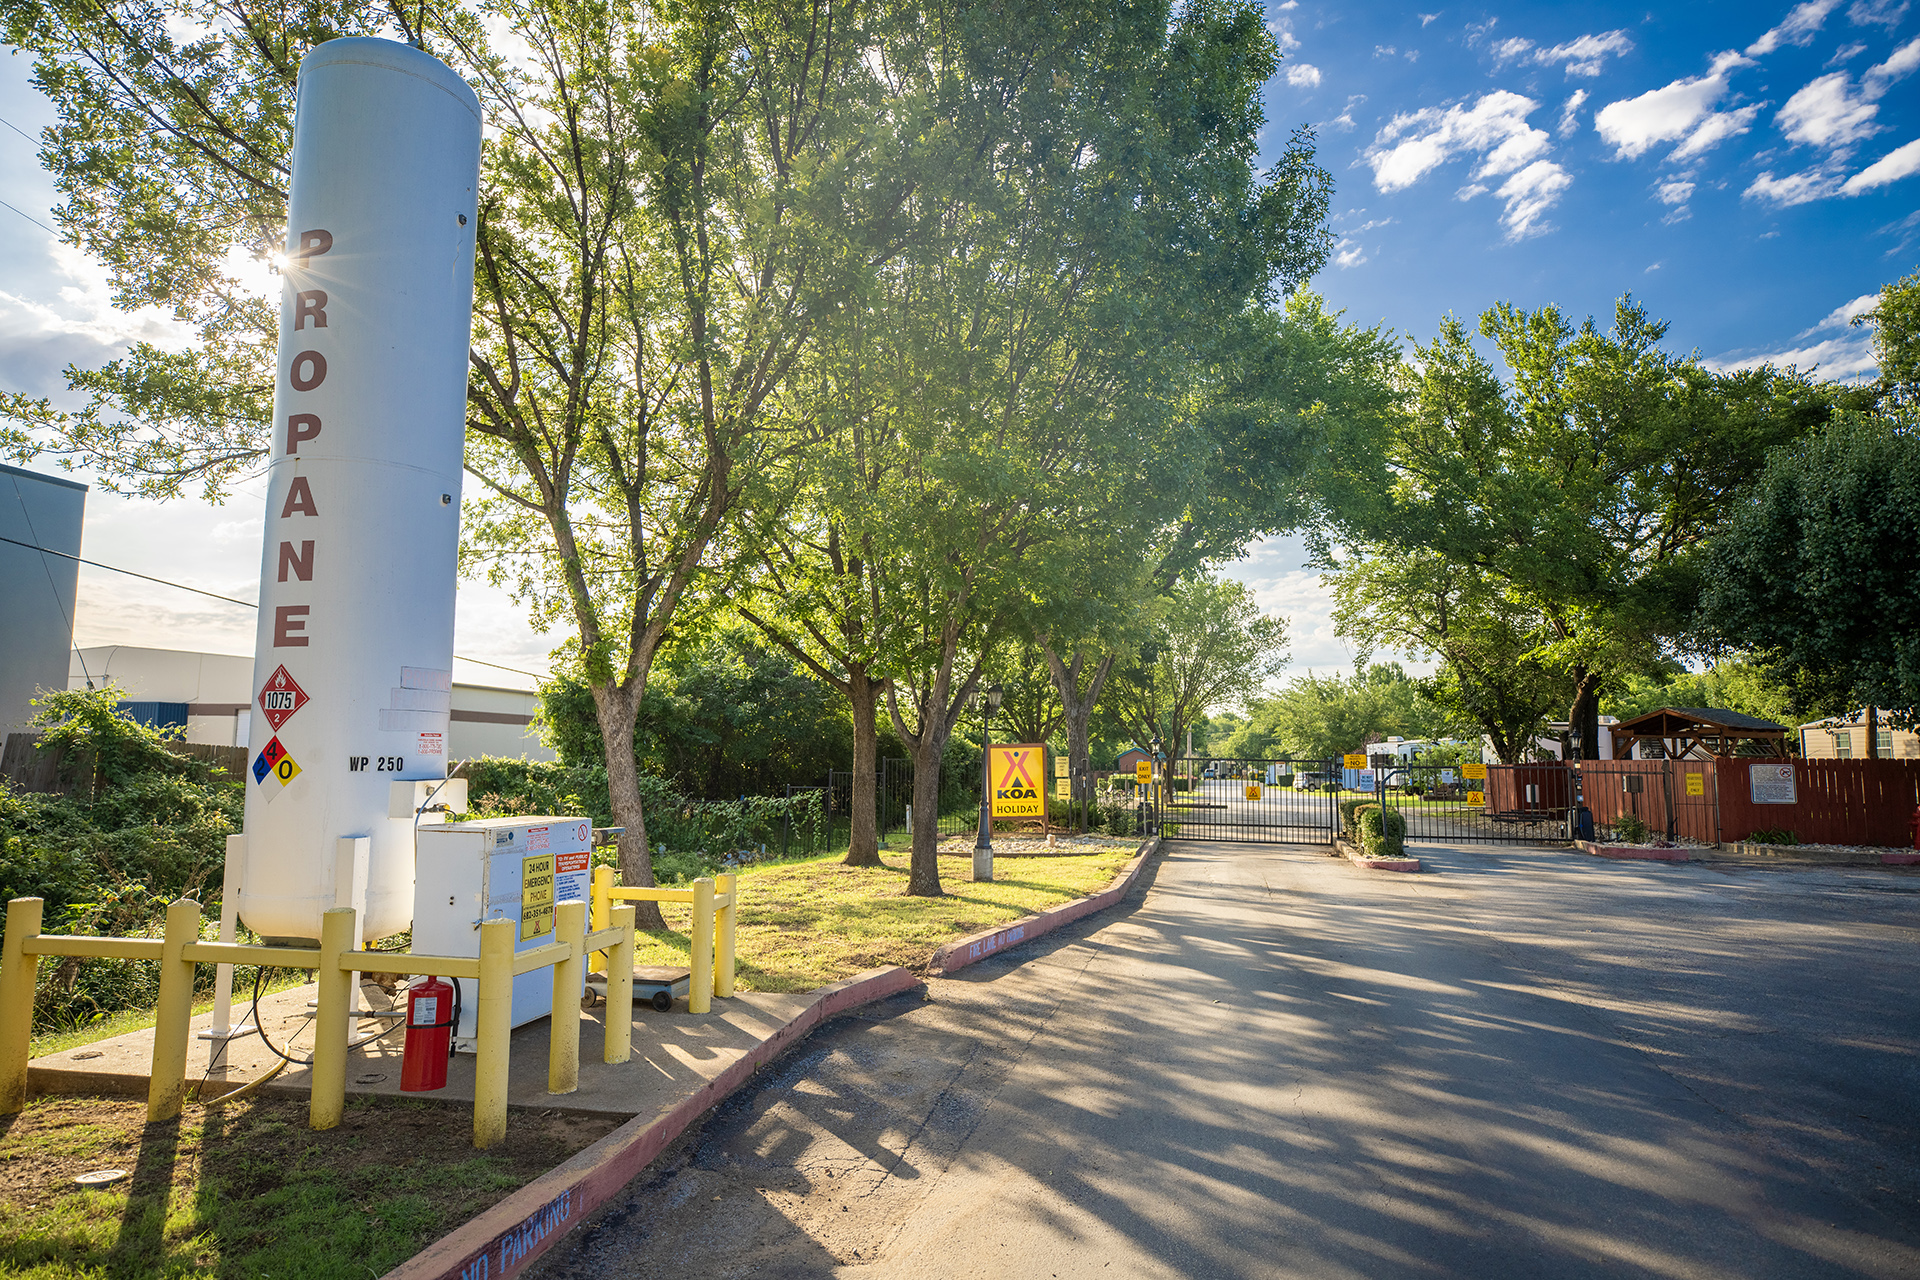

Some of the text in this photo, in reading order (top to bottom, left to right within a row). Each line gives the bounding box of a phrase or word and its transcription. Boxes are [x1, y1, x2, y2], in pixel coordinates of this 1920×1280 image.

[273, 229, 333, 648] PROPANE
[403, 669, 450, 690] PROPANE
[267, 691, 292, 709] 1075
[274, 713, 281, 723] 2
[266, 742, 278, 760] 4
[256, 758, 265, 777] 2
[349, 757, 404, 772] WP 250
[997, 789, 1037, 799] KOA
[996, 805, 1039, 813] HOLIDAY
[528, 861, 549, 874] 24 HOUR
[524, 874, 553, 889] EMERGENCY
[530, 889, 547, 902] PHONE
[983, 936, 996, 953] LANE
[500, 1190, 570, 1274] PARKING
